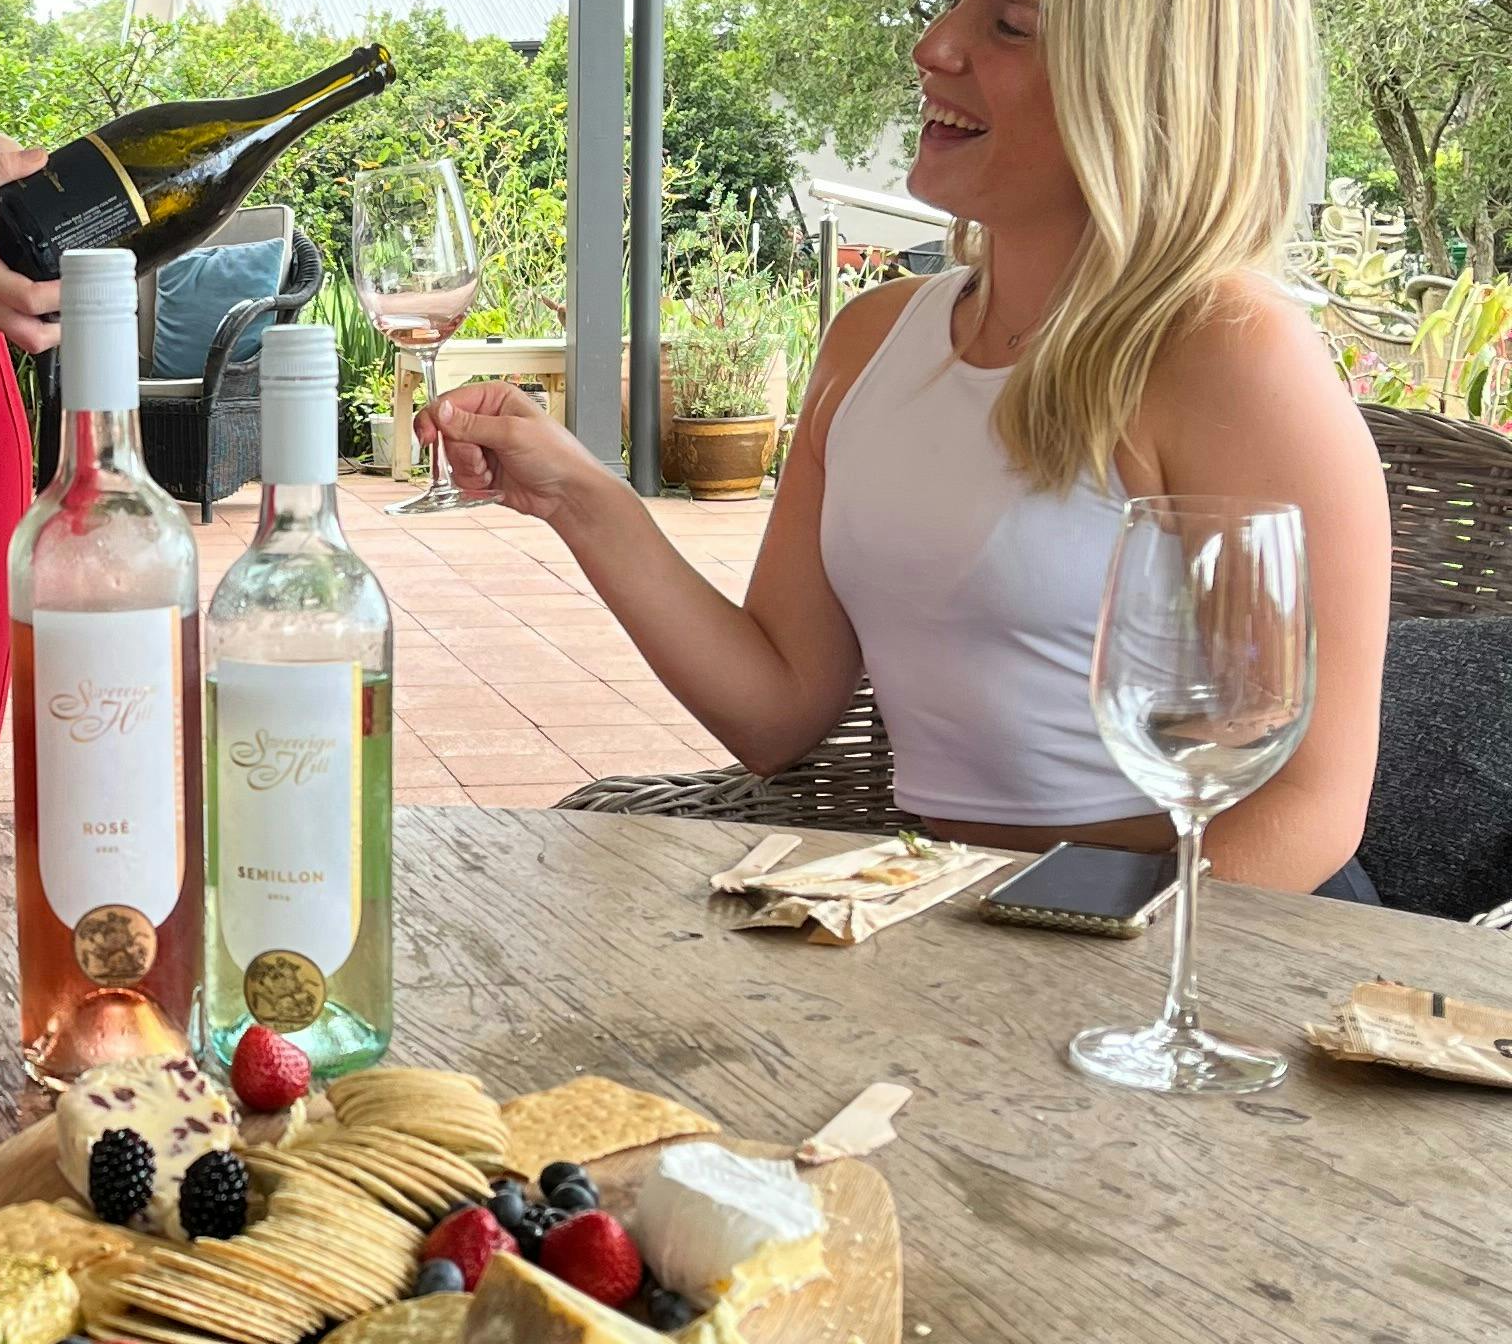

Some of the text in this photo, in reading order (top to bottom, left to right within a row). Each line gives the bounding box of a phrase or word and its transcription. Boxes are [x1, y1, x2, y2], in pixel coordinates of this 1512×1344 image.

[247, 751, 328, 791] Hill
[83, 819, 129, 835] ROSÉ
[238, 866, 325, 883] SEMILLON
